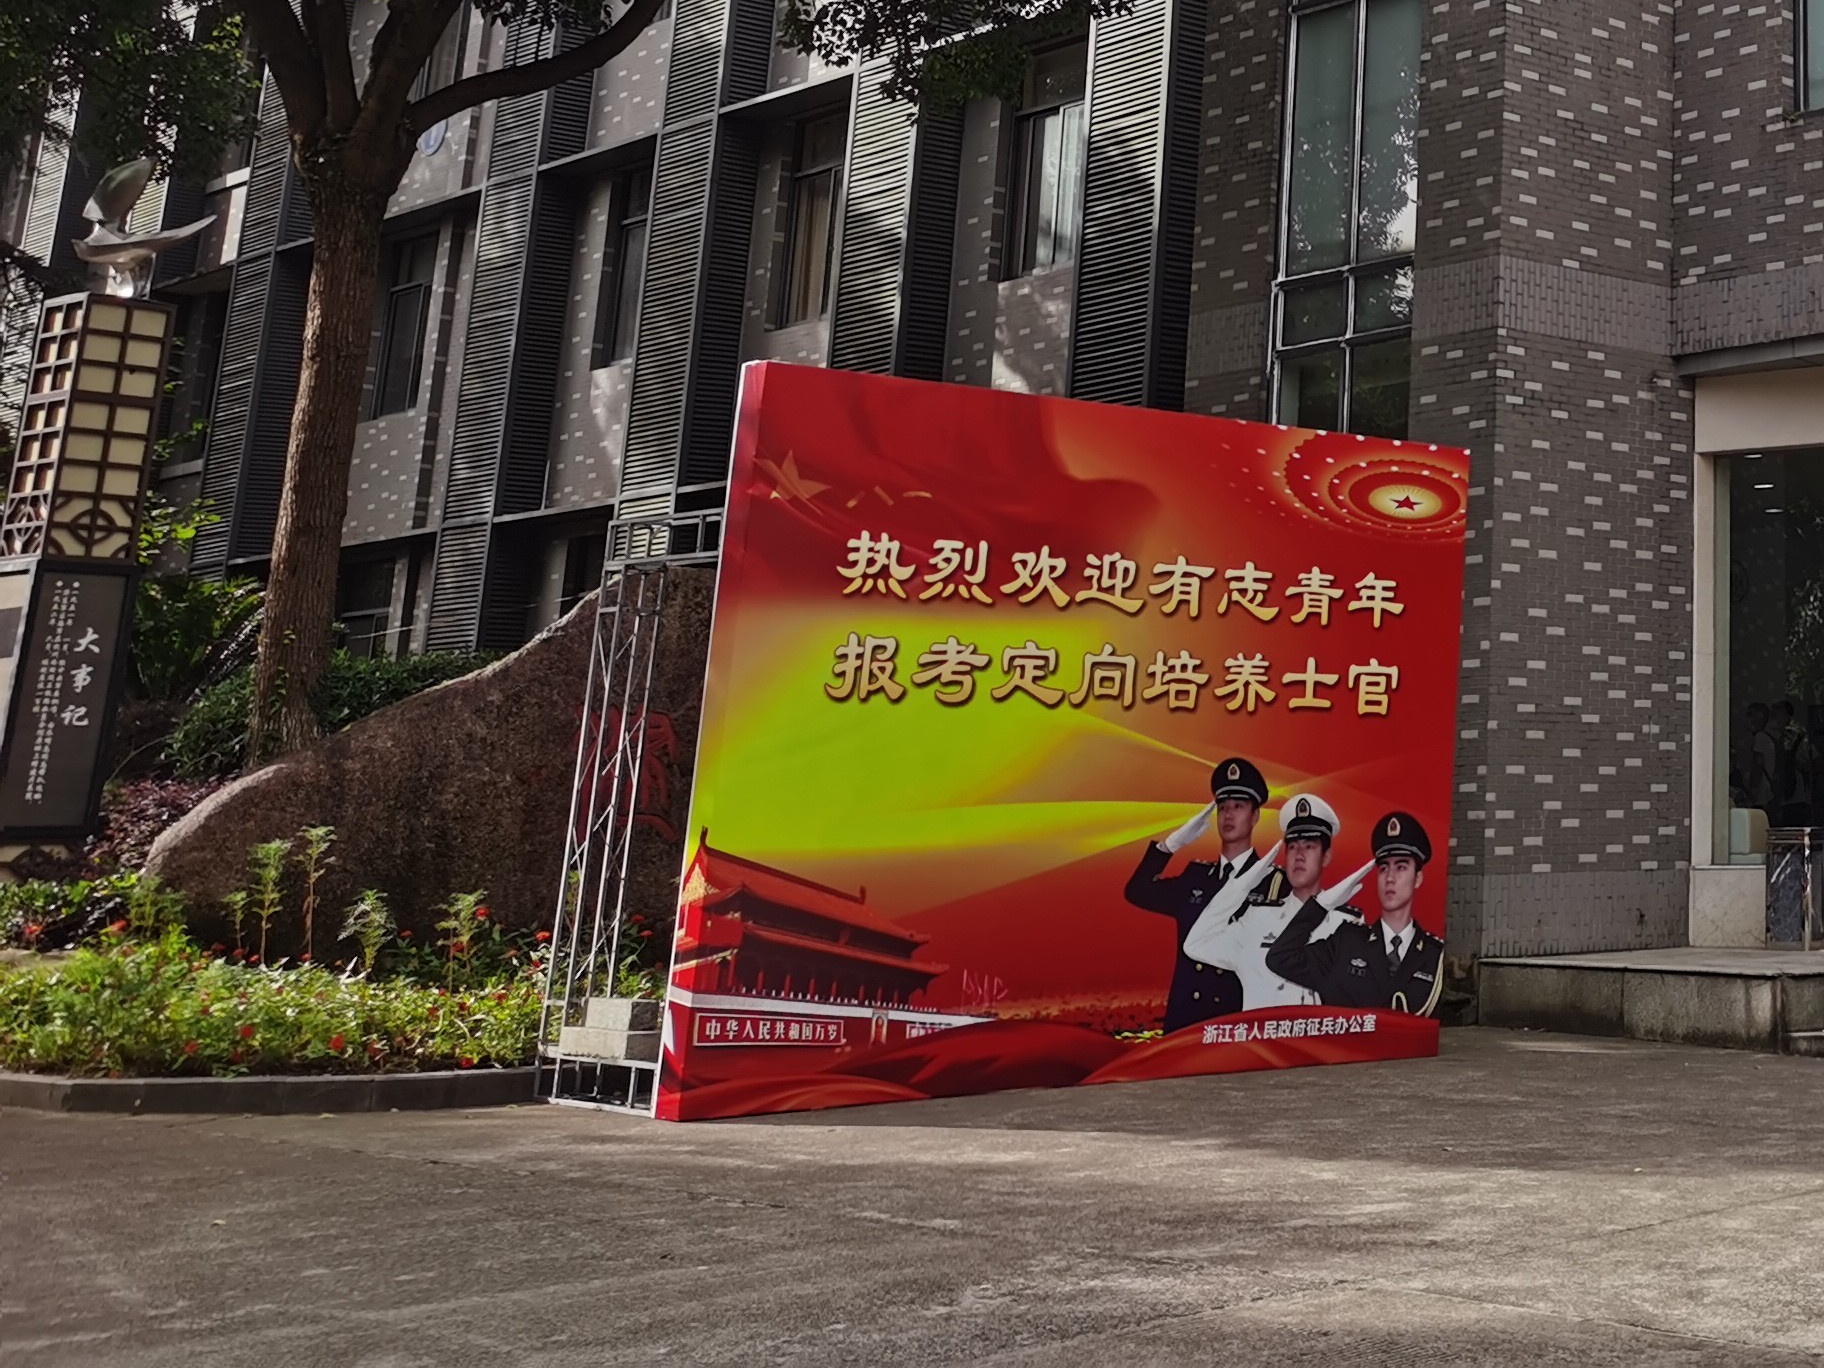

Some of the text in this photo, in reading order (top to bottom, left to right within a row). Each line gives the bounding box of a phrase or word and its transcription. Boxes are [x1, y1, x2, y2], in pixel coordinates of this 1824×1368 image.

[835, 529, 1405, 630] 热烈欢迎有志青年
[61, 627, 100, 726] 大事记
[823, 632, 1400, 717] 报考定向培养士官
[705, 1018, 838, 1042] 中华人民共和国万岁
[1202, 1013, 1377, 1044] 浙江省人民政府征兵办公室
